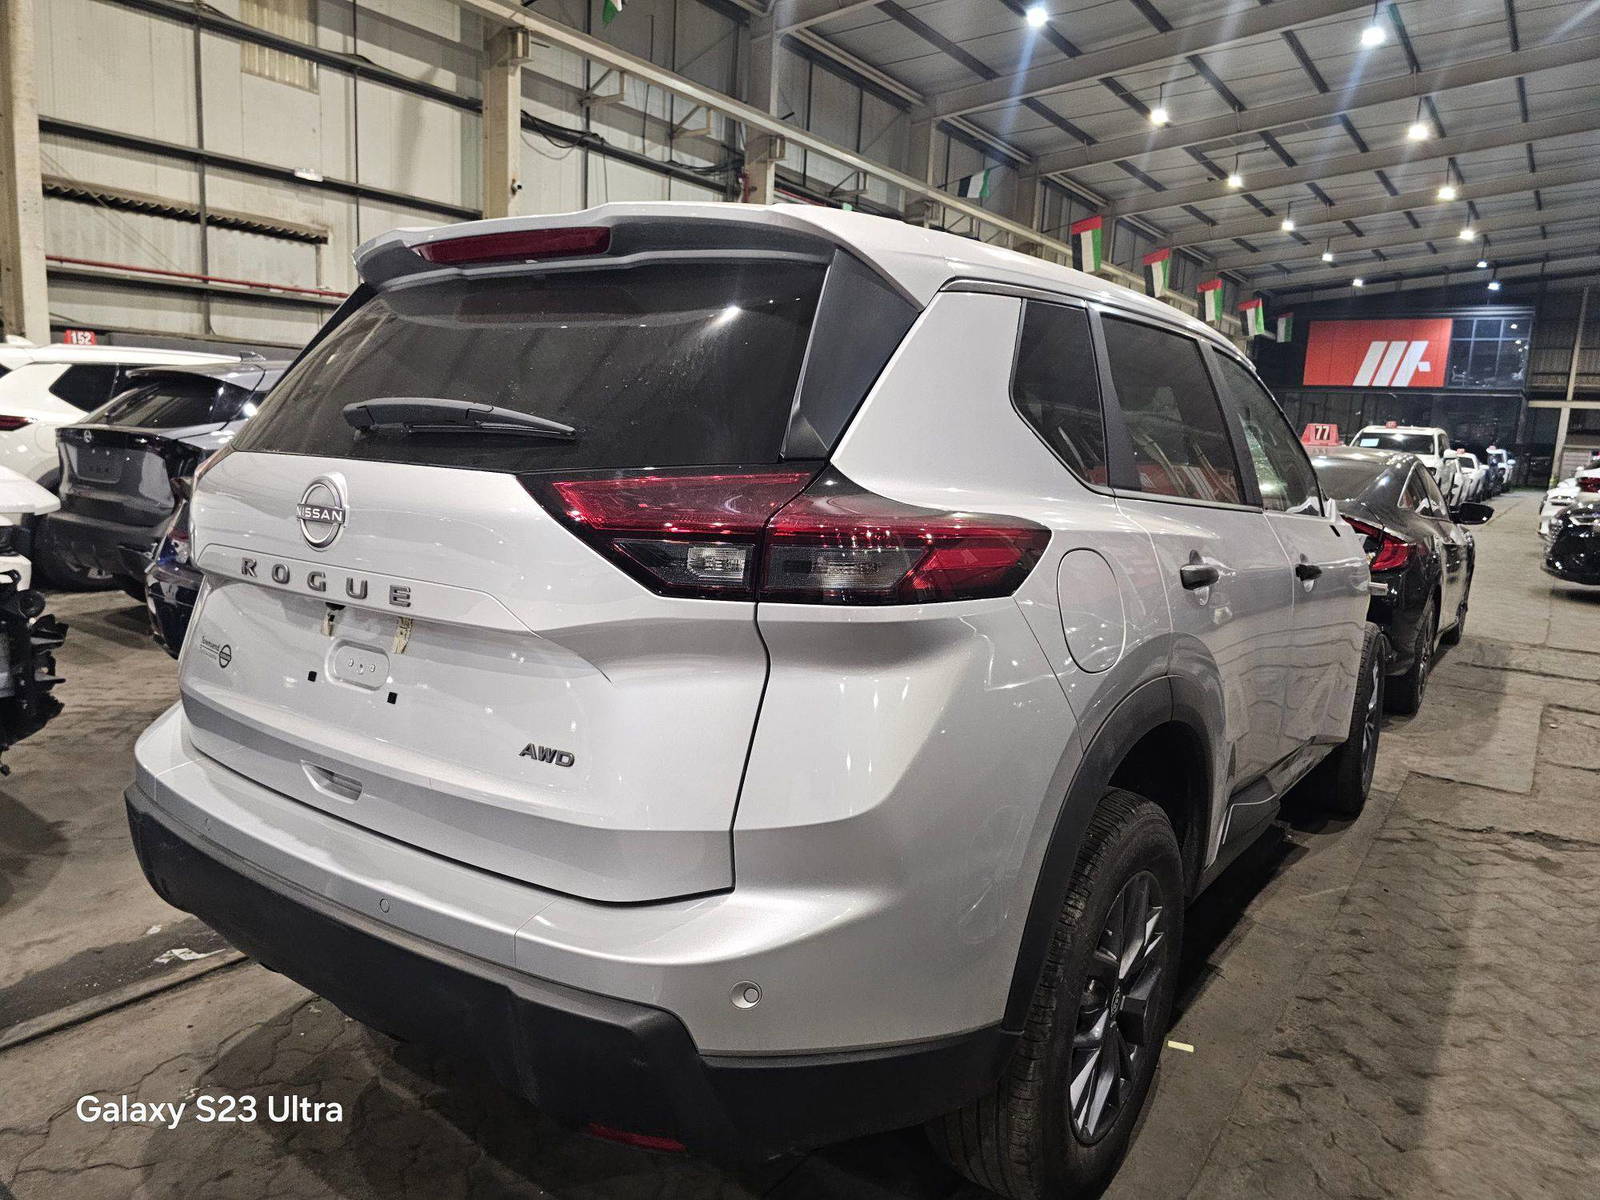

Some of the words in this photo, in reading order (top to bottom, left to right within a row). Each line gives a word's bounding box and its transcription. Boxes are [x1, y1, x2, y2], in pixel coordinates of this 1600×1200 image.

[71, 329, 92, 344] 152
[1315, 425, 1330, 440] 77
[297, 506, 342, 521] NISSAN
[241, 557, 412, 607] ROGUE
[518, 742, 575, 767] AWD
